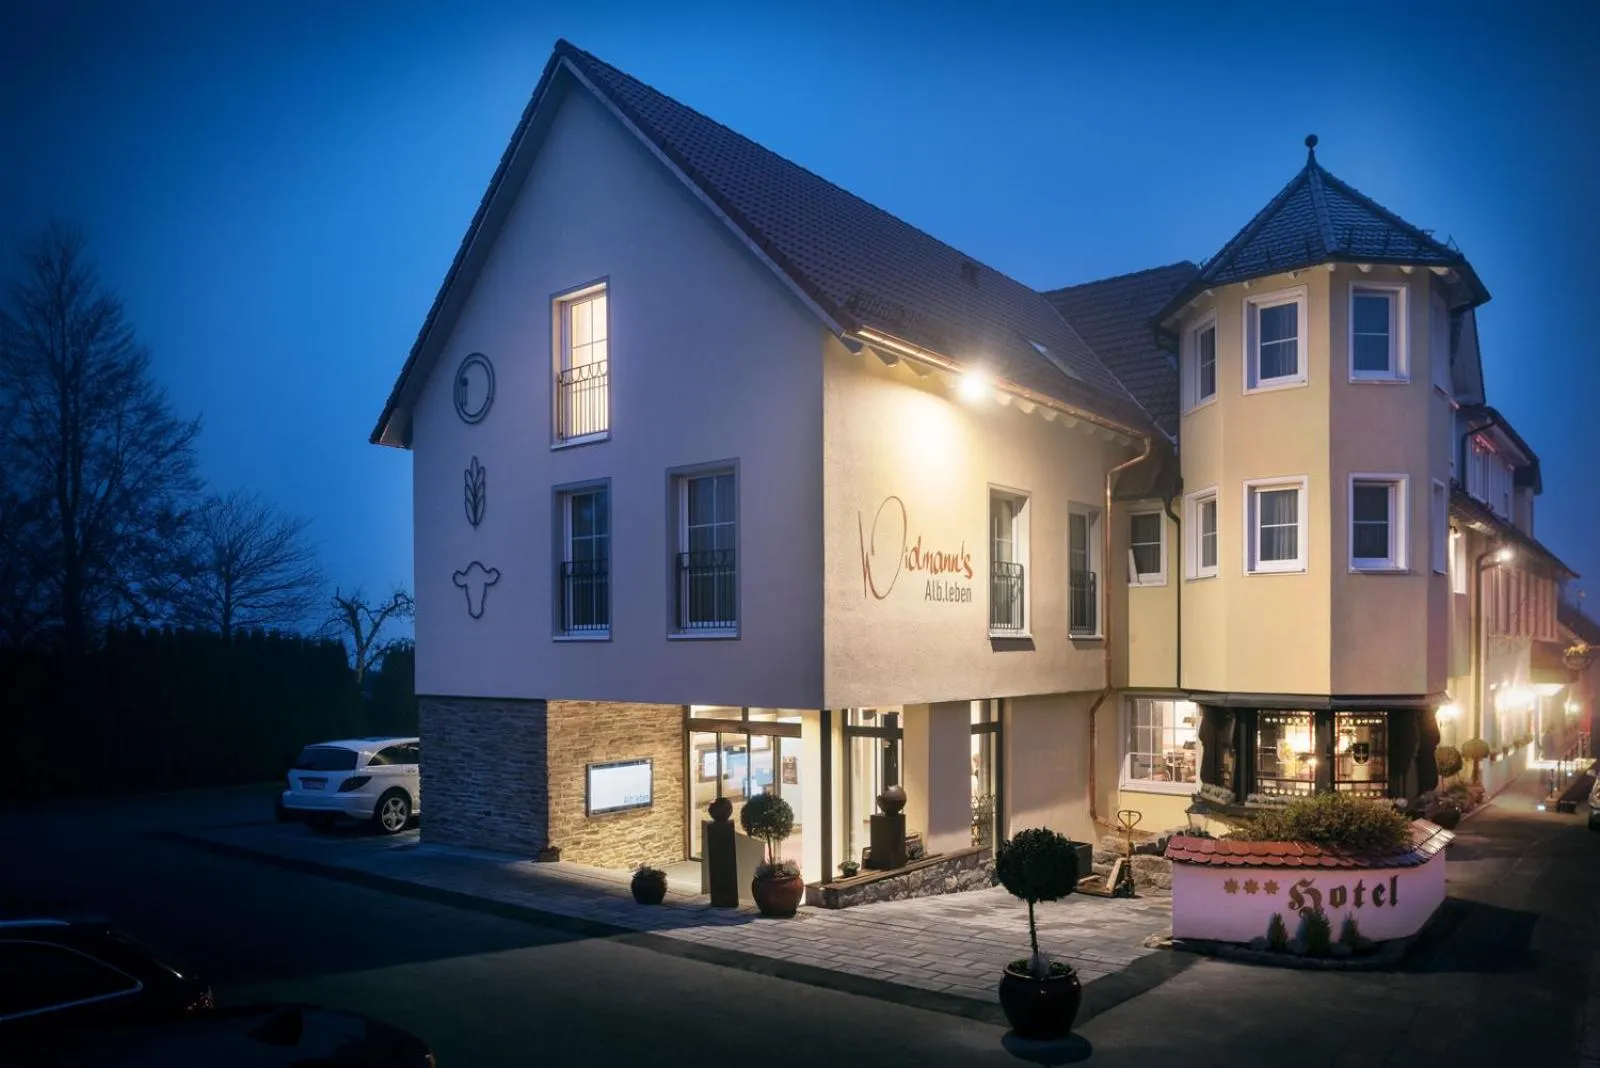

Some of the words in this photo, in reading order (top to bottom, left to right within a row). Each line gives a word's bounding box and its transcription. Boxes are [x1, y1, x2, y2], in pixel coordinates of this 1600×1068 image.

[858, 495, 973, 600] Widmann's
[924, 579, 973, 603] Alb.leben
[1288, 874, 1400, 919] Hotel
